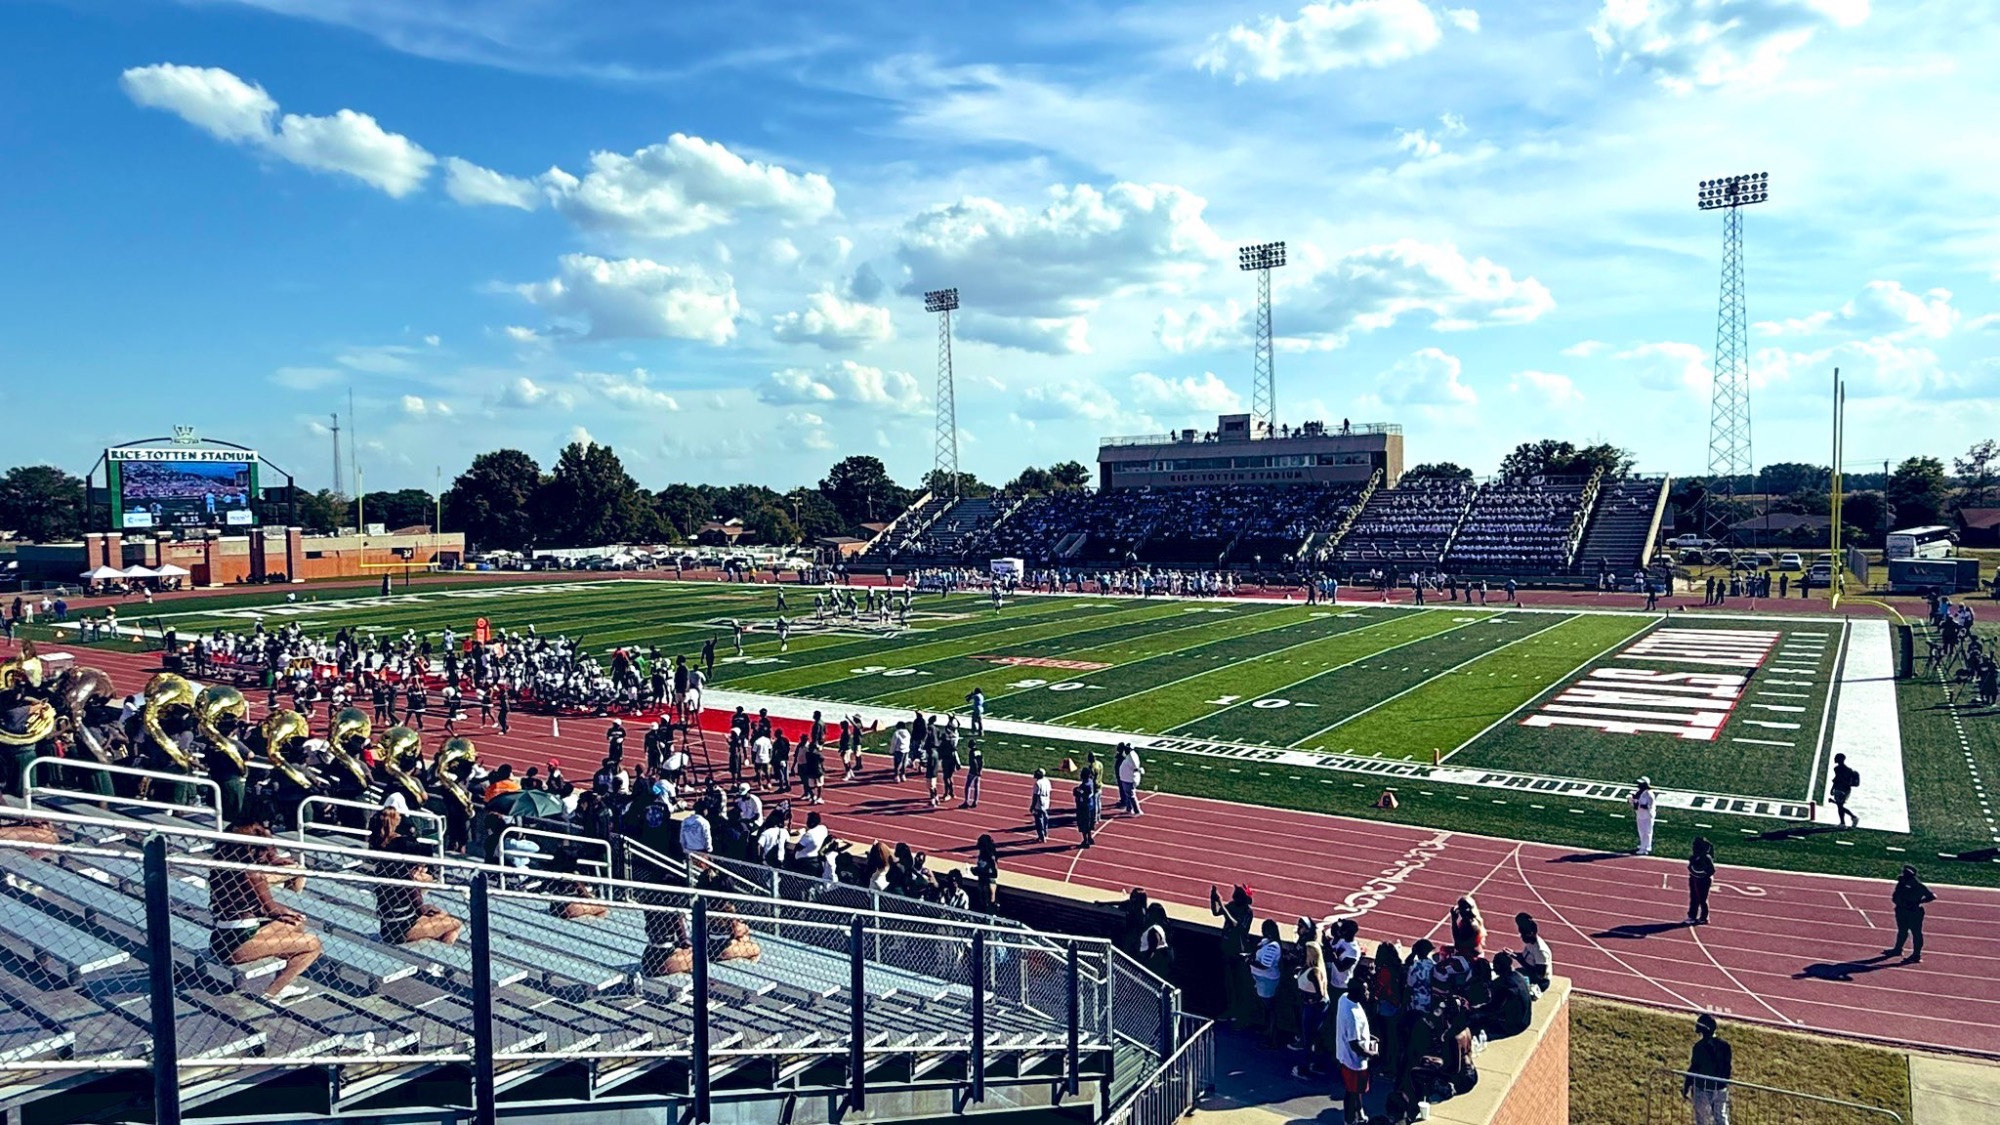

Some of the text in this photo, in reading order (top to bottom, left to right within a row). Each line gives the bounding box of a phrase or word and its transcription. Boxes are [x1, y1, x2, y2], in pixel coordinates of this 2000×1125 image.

[110, 450, 255, 461] RICE-TOTTEN STADIUM
[1250, 471, 1302, 481] STADIUM
[1203, 695, 1291, 709] 10
[1519, 667, 1750, 741] STATE
[1148, 738, 1287, 761] CHARLES
[1478, 772, 1666, 801] PROPHE
[1690, 795, 1811, 818] FIELD
